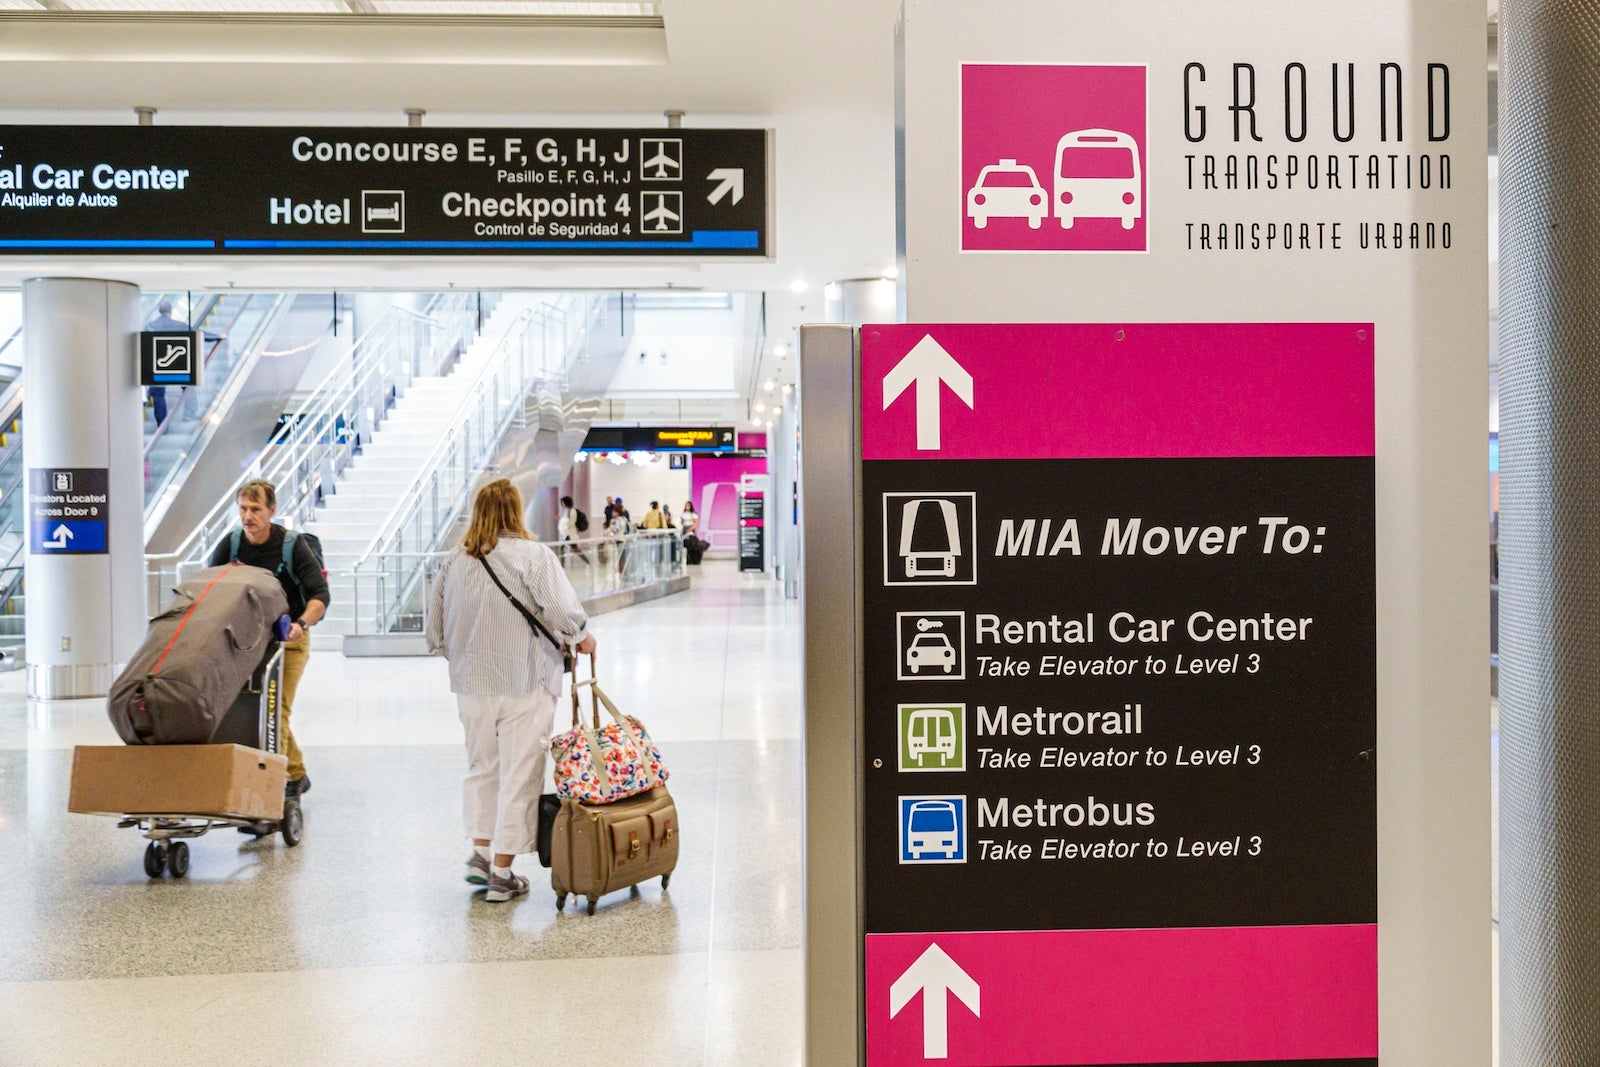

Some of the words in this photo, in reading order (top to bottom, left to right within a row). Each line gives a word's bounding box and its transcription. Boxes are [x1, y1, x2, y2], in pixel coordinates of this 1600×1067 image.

[1183, 61, 1451, 143] GROUND
[291, 136, 459, 163] Concourse
[467, 137, 496, 167] E,
[504, 137, 528, 167] F,
[535, 138, 568, 167] G,
[576, 138, 606, 167] H,
[613, 138, 630, 163] J
[32, 163, 85, 190] Car
[92, 163, 190, 190] Center
[497, 169, 545, 184] Pasillo
[548, 170, 563, 186] E,
[567, 170, 579, 186] F,
[583, 170, 600, 186] G,
[603, 170, 619, 185] H,
[622, 170, 631, 184] J
[1184, 154, 1451, 190] TRANSPORTATION
[1, 192, 54, 210] Alquiler
[56, 192, 75, 207] de
[78, 192, 118, 207] Autos
[269, 197, 351, 225] Hotel
[441, 191, 607, 222] Checkpoint
[614, 192, 632, 217] 4
[474, 221, 525, 236] Control
[528, 222, 546, 236] de
[549, 221, 619, 239] Seguridad
[622, 222, 632, 236] 4
[1185, 222, 1342, 250] TRANSPORTE
[1359, 222, 1452, 250] URBANO
[64, 507, 89, 516] Door
[90, 506, 98, 516] 9
[66, 494, 107, 503] Located
[994, 518, 1082, 557] MIA
[1100, 517, 1248, 556] Mover
[1258, 516, 1327, 555] To:
[975, 612, 1094, 644] Rental
[1108, 611, 1175, 643] Car
[1186, 610, 1313, 643] Center
[976, 656, 1031, 677] Take
[1038, 655, 1139, 676] Elevator
[1145, 655, 1167, 675] to
[1174, 653, 1239, 675] Level
[1246, 652, 1261, 674] 3
[976, 703, 1142, 736] Metrorail
[976, 747, 1032, 769] Take
[1039, 747, 1140, 768] Elevator
[1146, 746, 1168, 767] to
[1175, 744, 1240, 766] Level
[1246, 744, 1262, 765] 3
[977, 795, 1156, 828] Metrobus
[977, 839, 1032, 861] Take
[1040, 838, 1141, 860] Elevator
[1146, 838, 1169, 858] to
[1176, 836, 1241, 857] Level
[1247, 835, 1262, 856] 3
